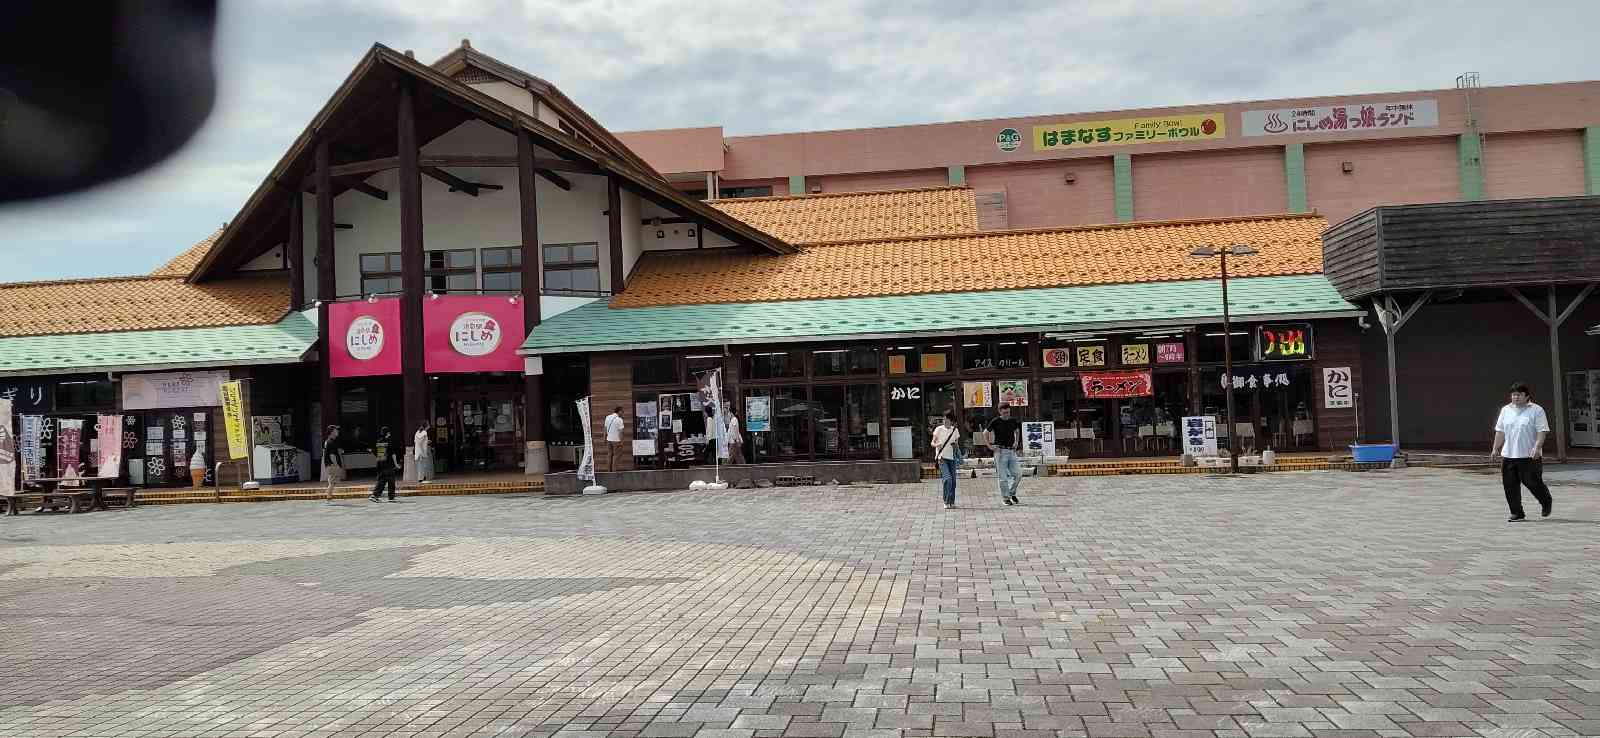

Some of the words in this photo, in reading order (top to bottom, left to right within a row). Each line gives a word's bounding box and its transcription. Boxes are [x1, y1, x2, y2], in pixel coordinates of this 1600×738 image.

[351, 334, 378, 346] にしめ
[455, 329, 493, 342] にしめ
[1079, 349, 1104, 363] 定食
[1090, 379, 1142, 394] ラーメン
[1327, 369, 1349, 399] かに
[890, 386, 921, 400] かに
